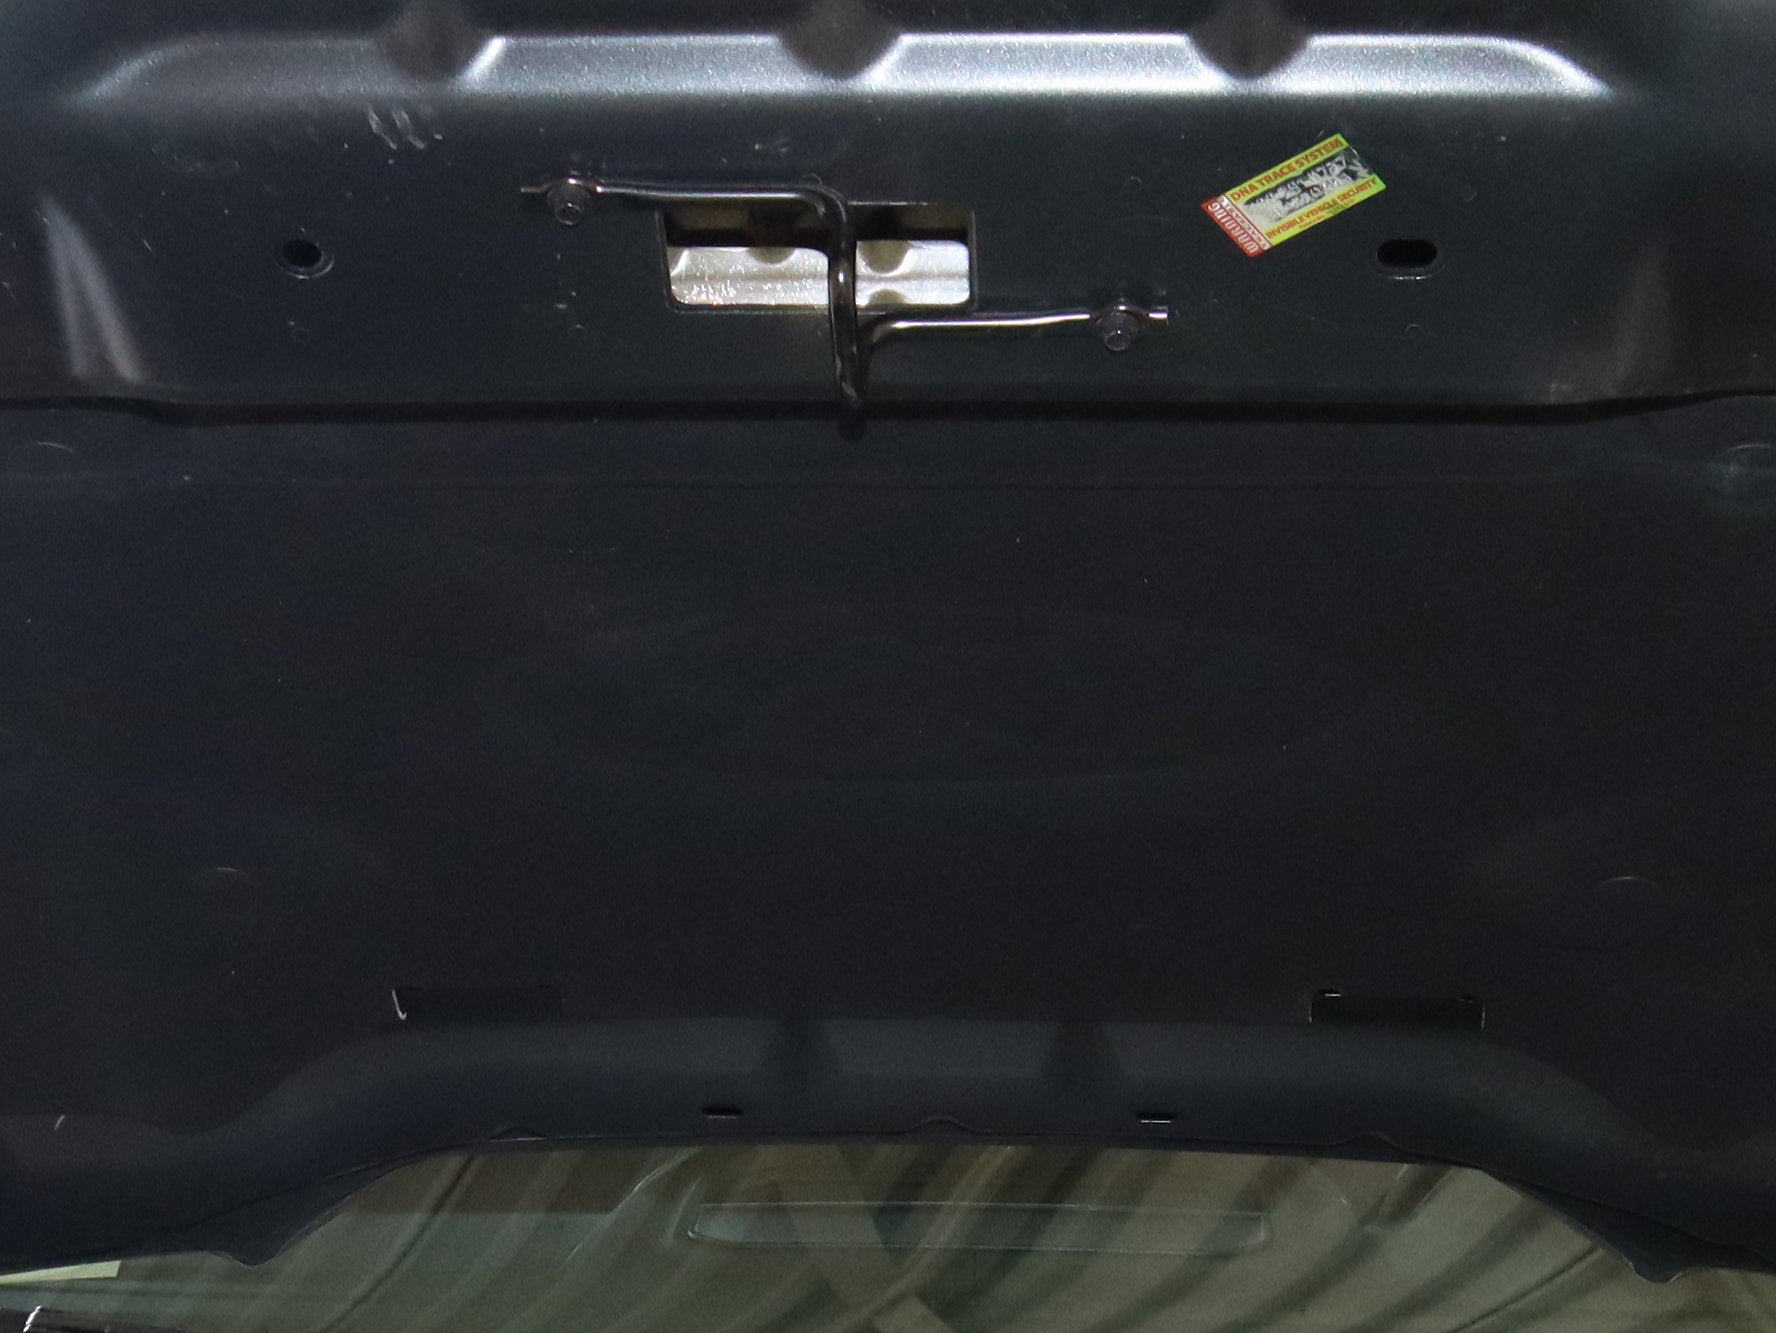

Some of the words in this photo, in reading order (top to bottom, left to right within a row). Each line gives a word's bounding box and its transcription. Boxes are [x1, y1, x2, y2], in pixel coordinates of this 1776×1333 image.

[1230, 182, 1259, 201] DNA
[1259, 163, 1298, 188] TRACE
[1295, 137, 1346, 168] SYSTEM
[1335, 177, 1379, 207] SECURITY
[1207, 202, 1260, 255] WARNING
